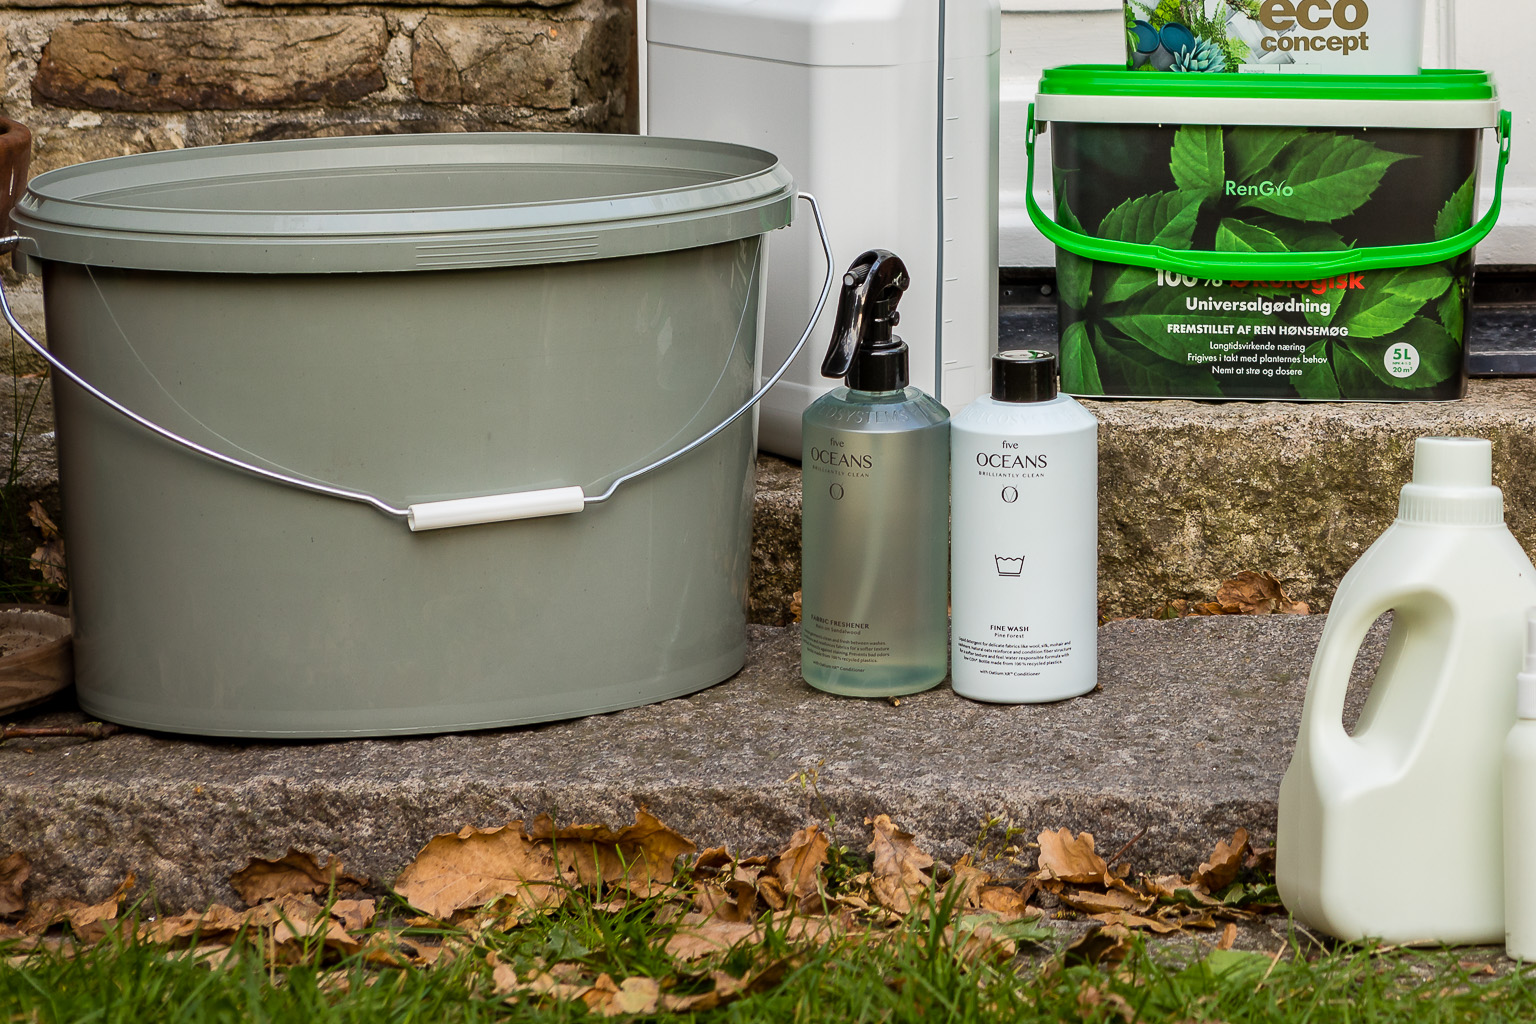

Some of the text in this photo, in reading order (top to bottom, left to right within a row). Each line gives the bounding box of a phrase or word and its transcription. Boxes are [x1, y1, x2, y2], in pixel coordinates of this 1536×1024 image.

[1261, 32, 1369, 55] concept
[1186, 297, 1330, 316] Universalgødning
[1168, 324, 1348, 336] FREMSTILLET AF REN HØNSEMØG
[1210, 341, 1305, 353] Langtidsvirkende næring
[1188, 353, 1327, 364] Frigives i takt med planternes behov
[1393, 349, 1411, 360] 5 L
[1212, 366, 1234, 374] Nemt
[1246, 367, 1260, 375] strø
[1263, 369, 1273, 377] og
[1275, 367, 1302, 375] dosere
[830, 438, 844, 447] five
[1002, 440, 1018, 449] five
[811, 447, 872, 468] OCEANS
[977, 453, 1048, 468] OCEANS
[811, 614, 829, 624] FABRIC
[830, 620, 869, 629] FRESHENER
